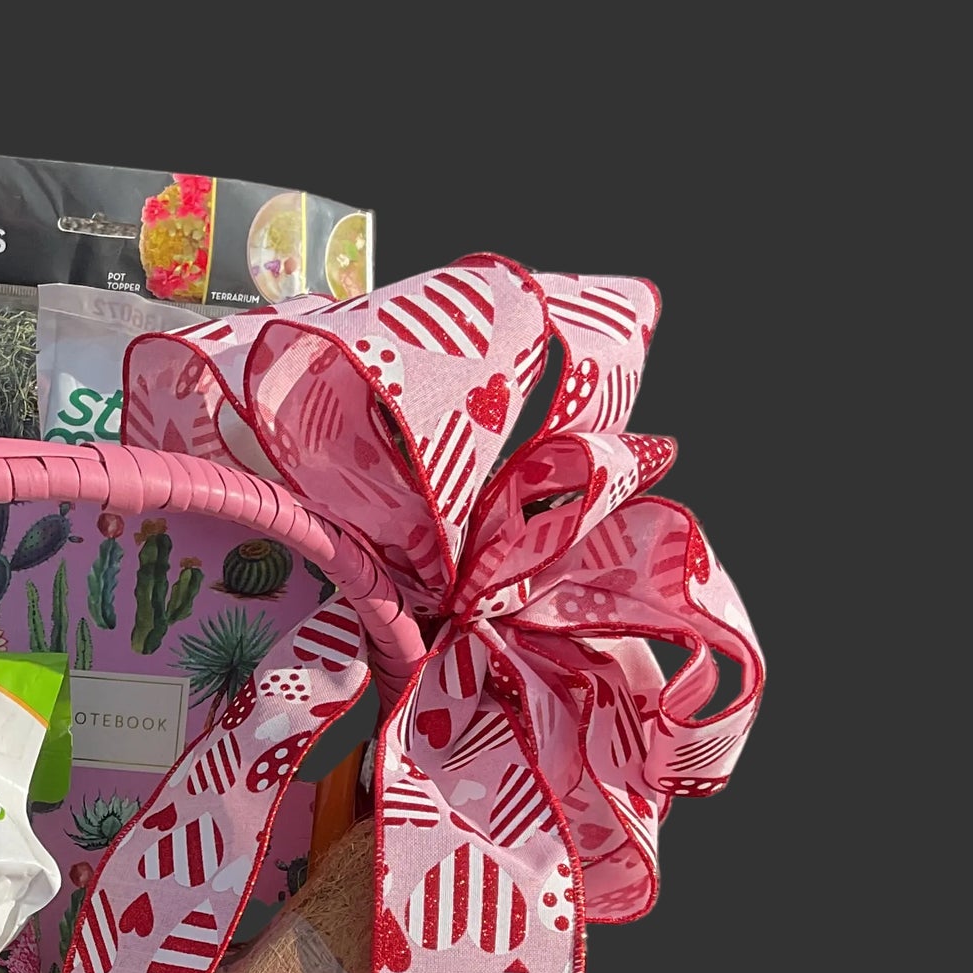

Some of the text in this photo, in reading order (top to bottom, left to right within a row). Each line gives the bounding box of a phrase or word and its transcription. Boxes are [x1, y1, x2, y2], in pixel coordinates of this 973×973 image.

[107, 272, 126, 282] POT
[107, 282, 141, 292] TOPPER
[211, 291, 260, 304] TERRARIUM
[57, 388, 124, 441] st
[75, 712, 167, 731] OTEBOOK
